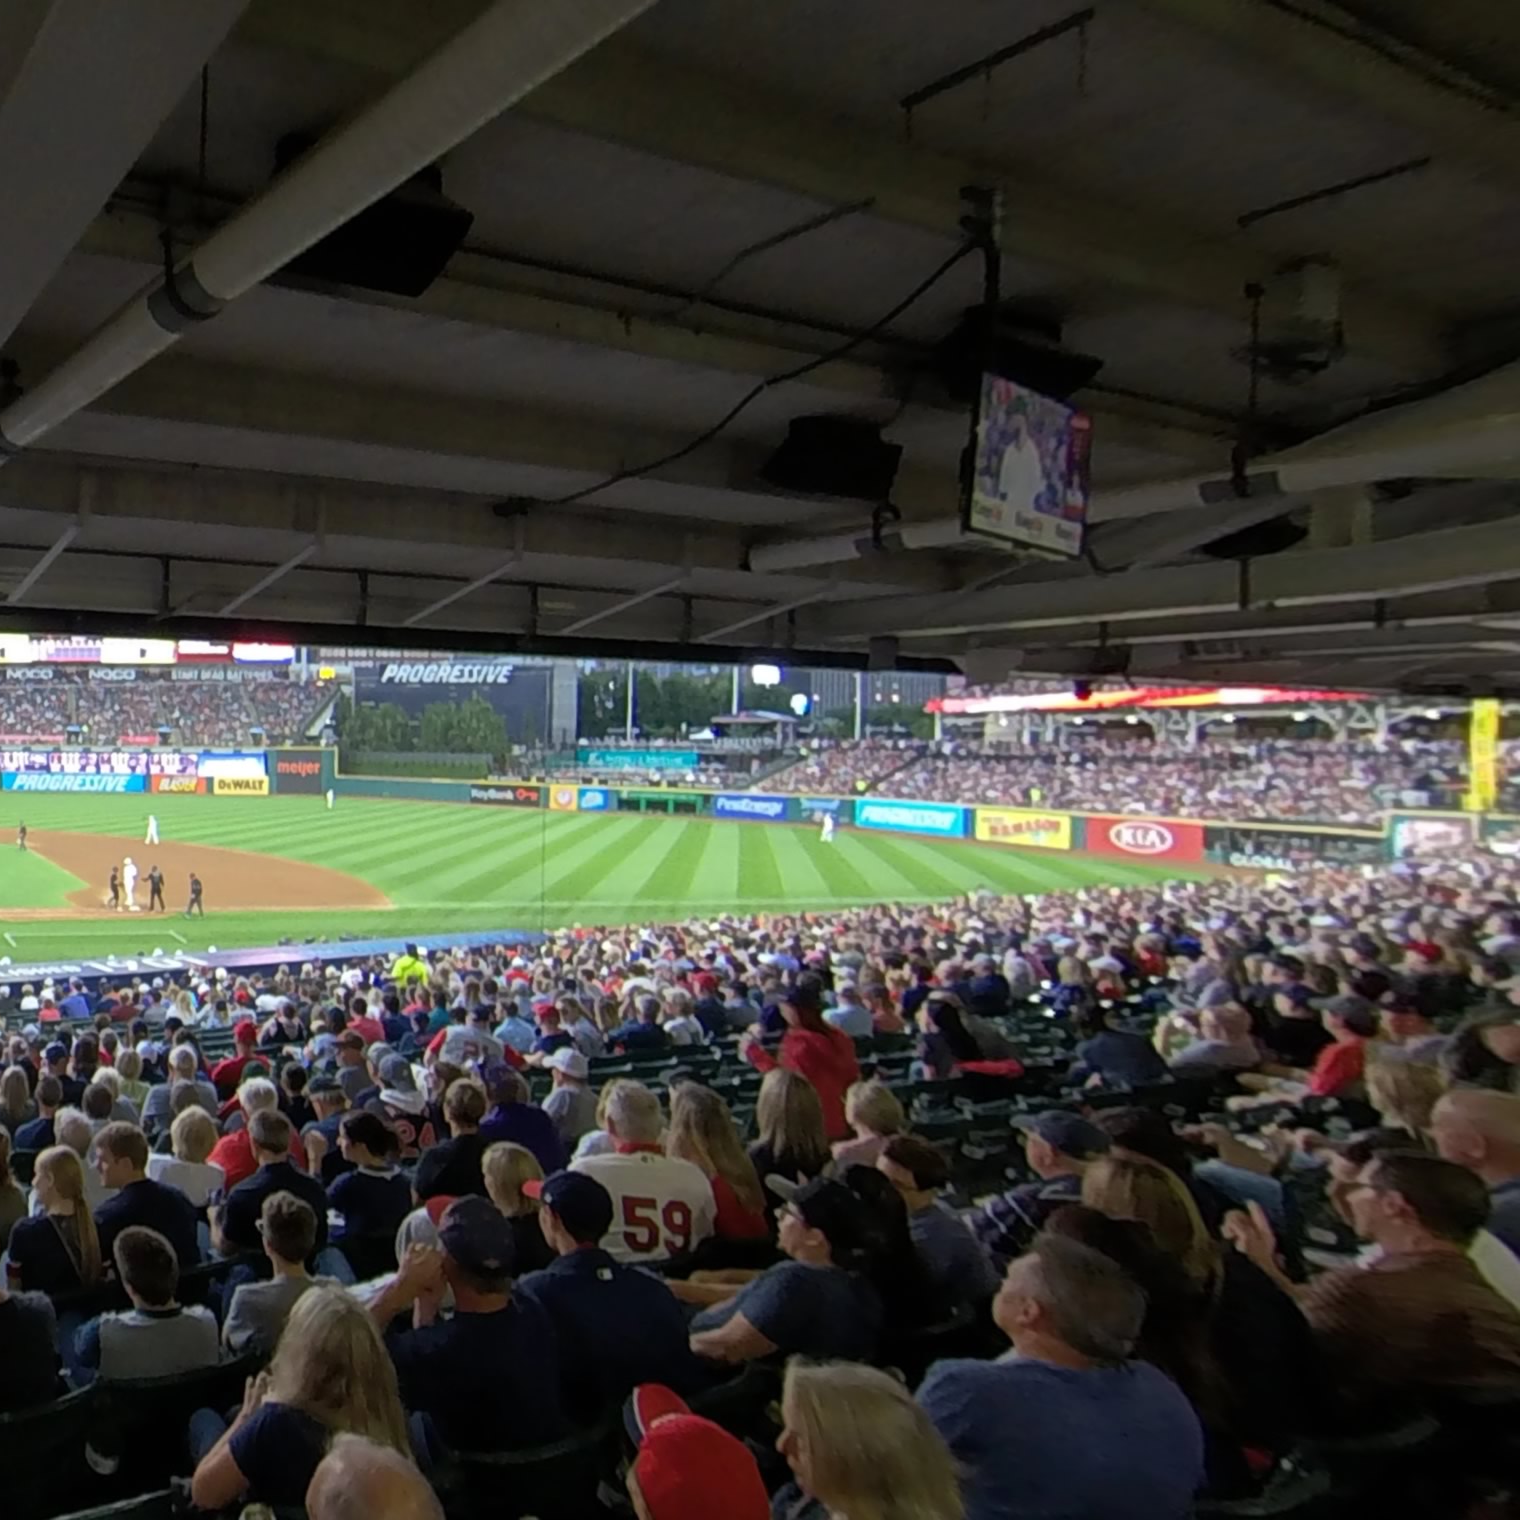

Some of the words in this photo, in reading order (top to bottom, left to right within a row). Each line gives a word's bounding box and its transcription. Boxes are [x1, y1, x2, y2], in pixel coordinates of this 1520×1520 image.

[6, 669, 54, 679] NOCO
[89, 669, 136, 680] NOCO
[381, 664, 514, 684] PROGRESSIVE
[277, 761, 320, 777] meijer
[13, 775, 130, 791] PROGRESSIVE
[1120, 828, 1163, 847] KIA
[622, 1195, 692, 1254] 59
